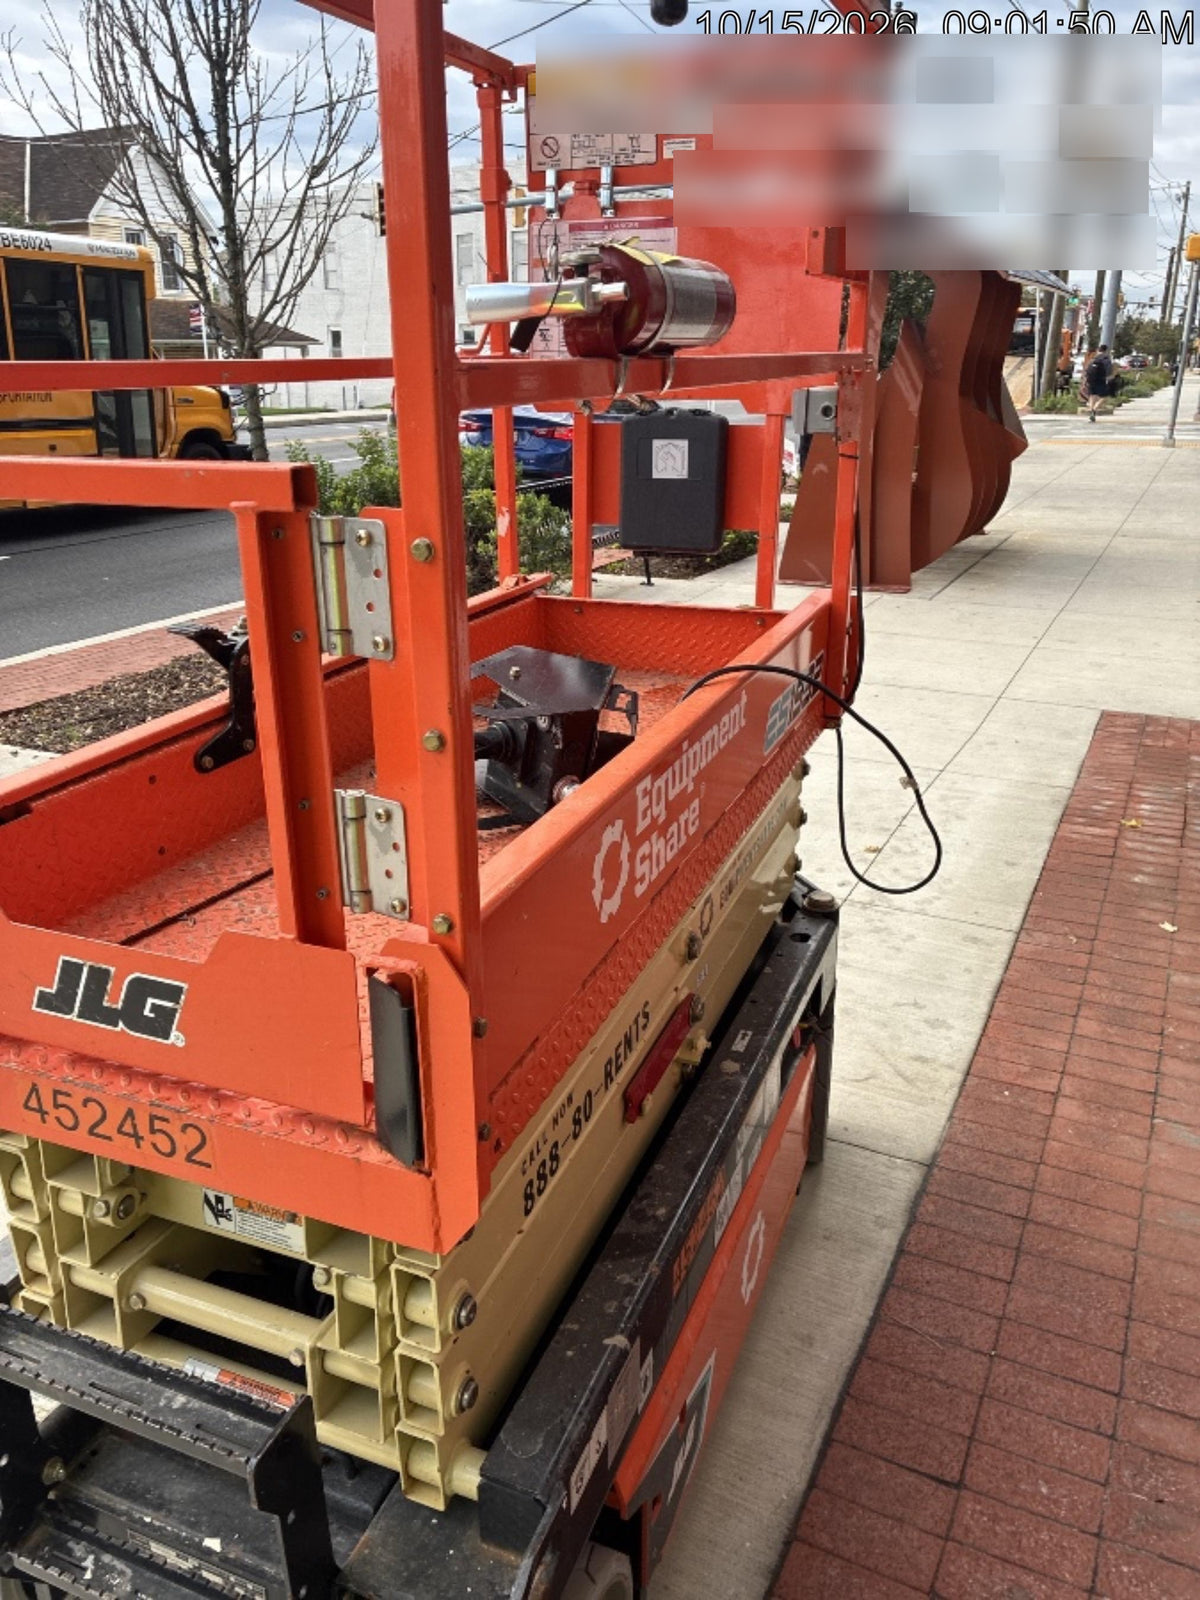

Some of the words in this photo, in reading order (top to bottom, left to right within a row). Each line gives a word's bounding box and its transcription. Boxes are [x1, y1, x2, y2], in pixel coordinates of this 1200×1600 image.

[636, 690, 748, 836] Equipment
[634, 798, 700, 898] Share
[32, 955, 188, 1044] JLG
[23, 1081, 212, 1169] 452452
[523, 1000, 651, 1218] 888-80-RENTS
